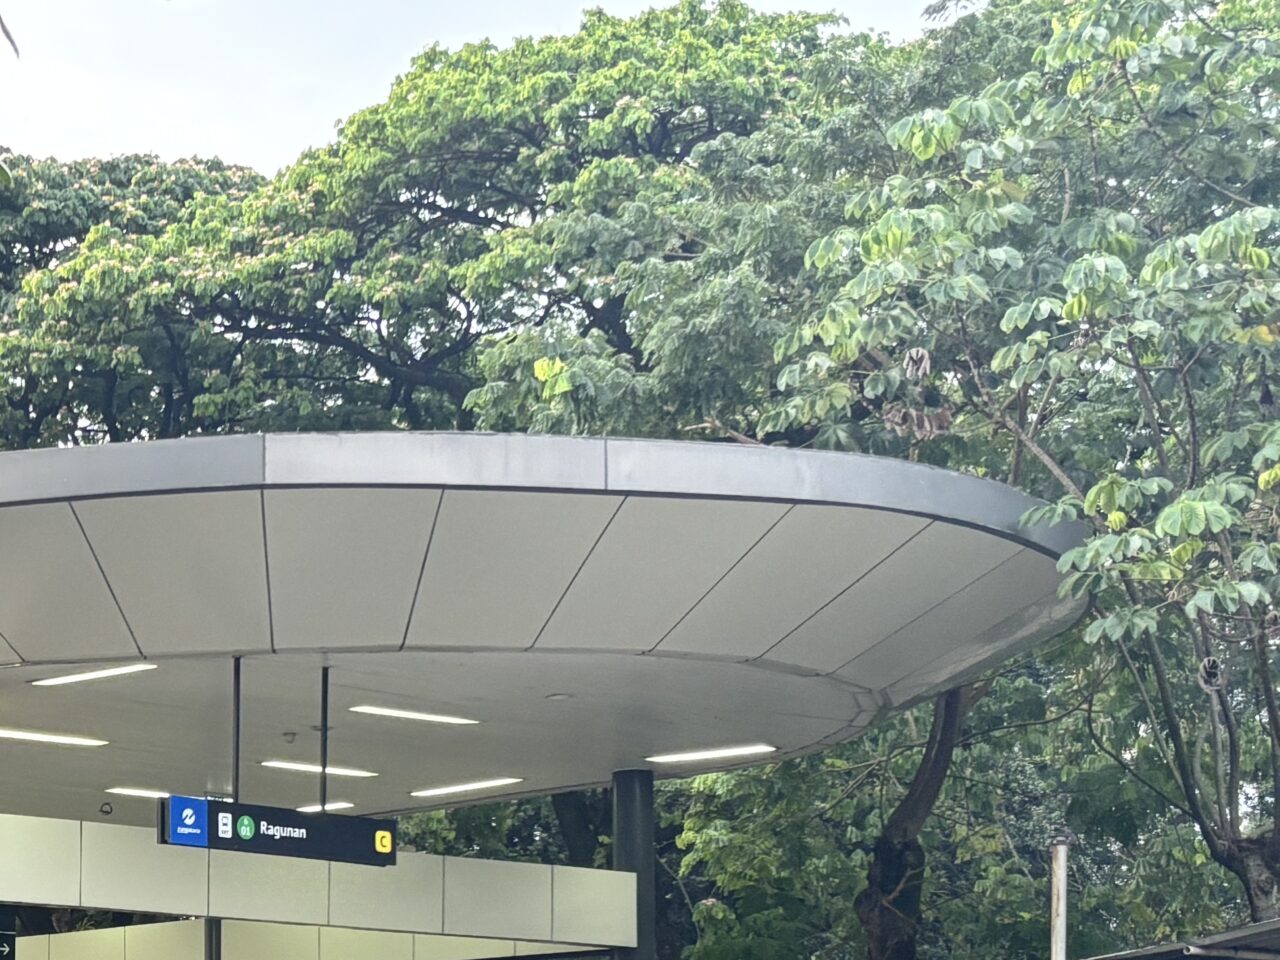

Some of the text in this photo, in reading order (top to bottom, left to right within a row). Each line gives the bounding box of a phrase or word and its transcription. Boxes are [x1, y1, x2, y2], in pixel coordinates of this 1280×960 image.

[240, 826, 251, 836] 01
[260, 821, 306, 839] Ragunan
[379, 835, 387, 848] C
